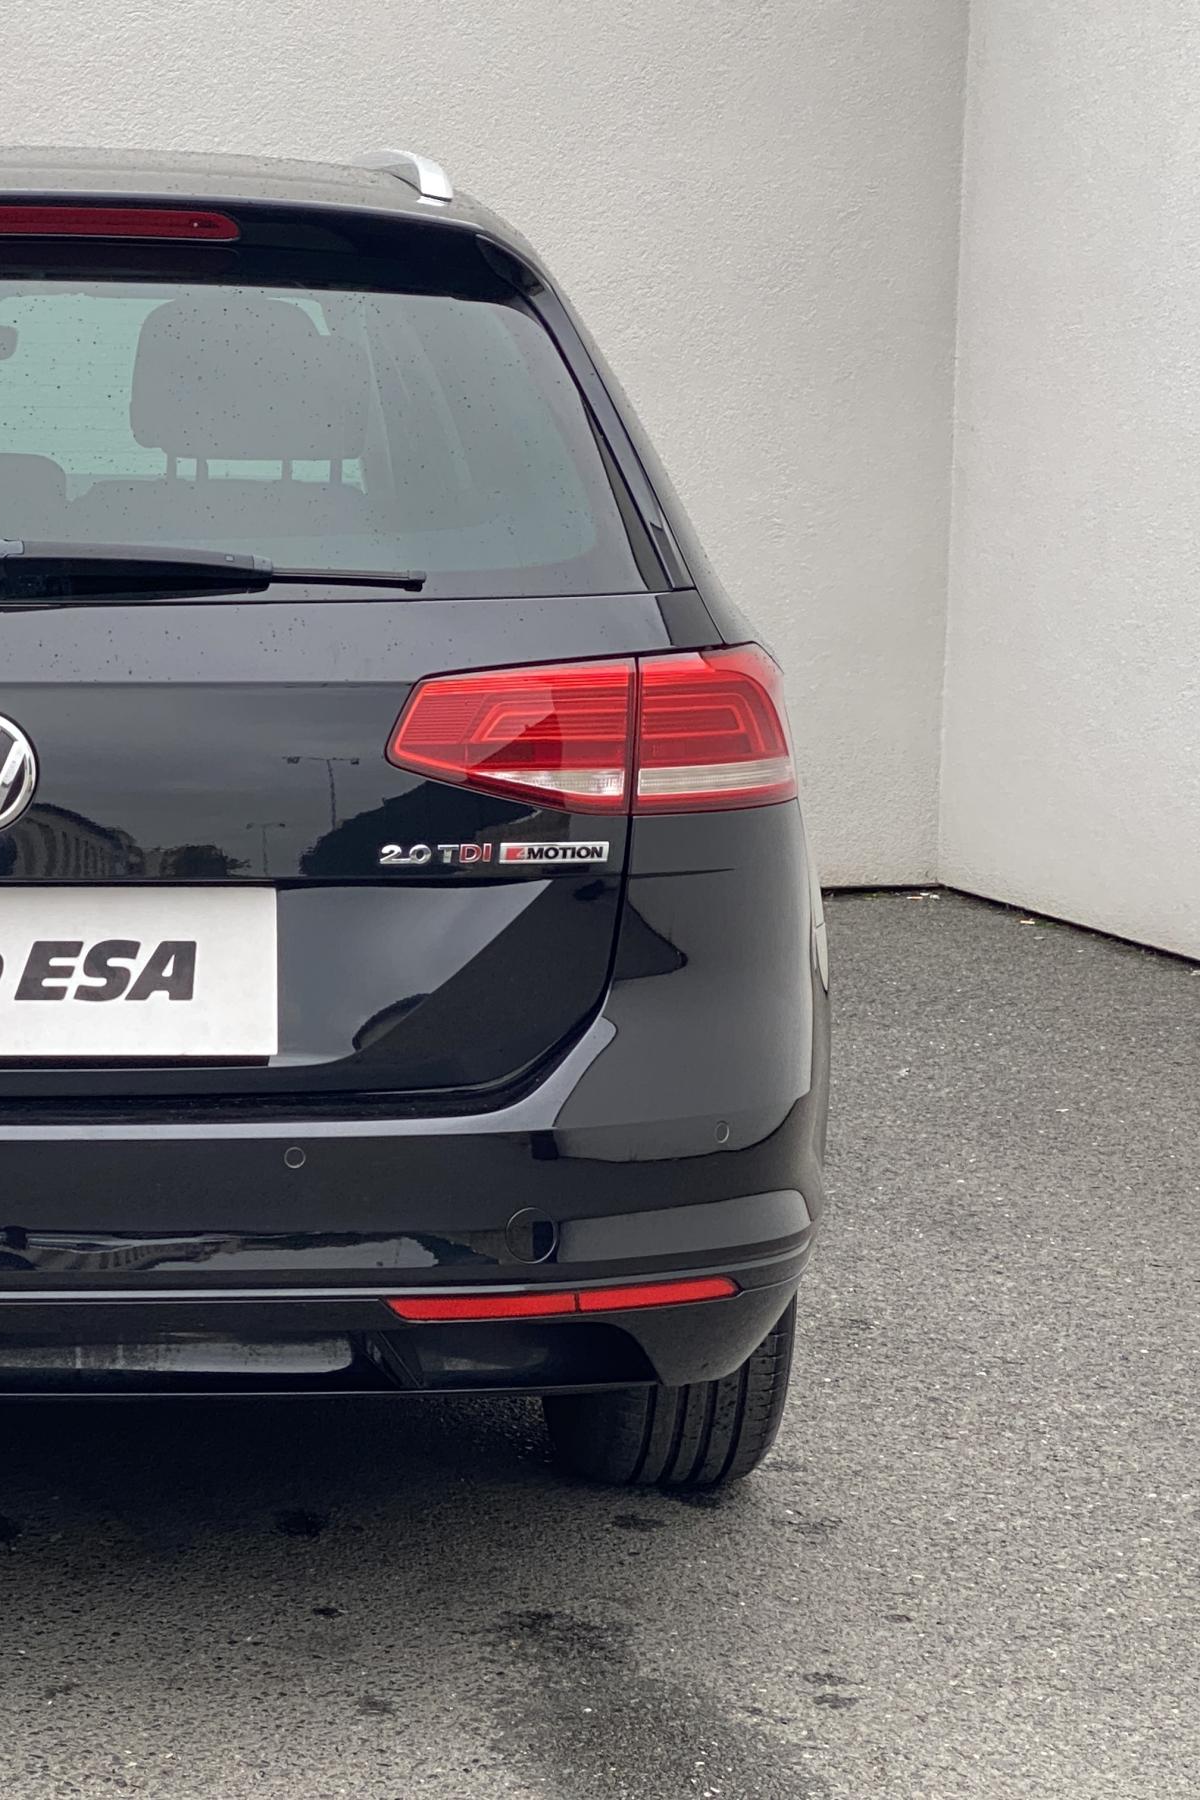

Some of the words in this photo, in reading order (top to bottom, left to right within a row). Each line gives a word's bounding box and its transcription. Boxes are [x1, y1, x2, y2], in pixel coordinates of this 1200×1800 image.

[380, 844, 431, 864] 2.0
[437, 843, 492, 864] TDI
[13, 940, 197, 1002] ESA
